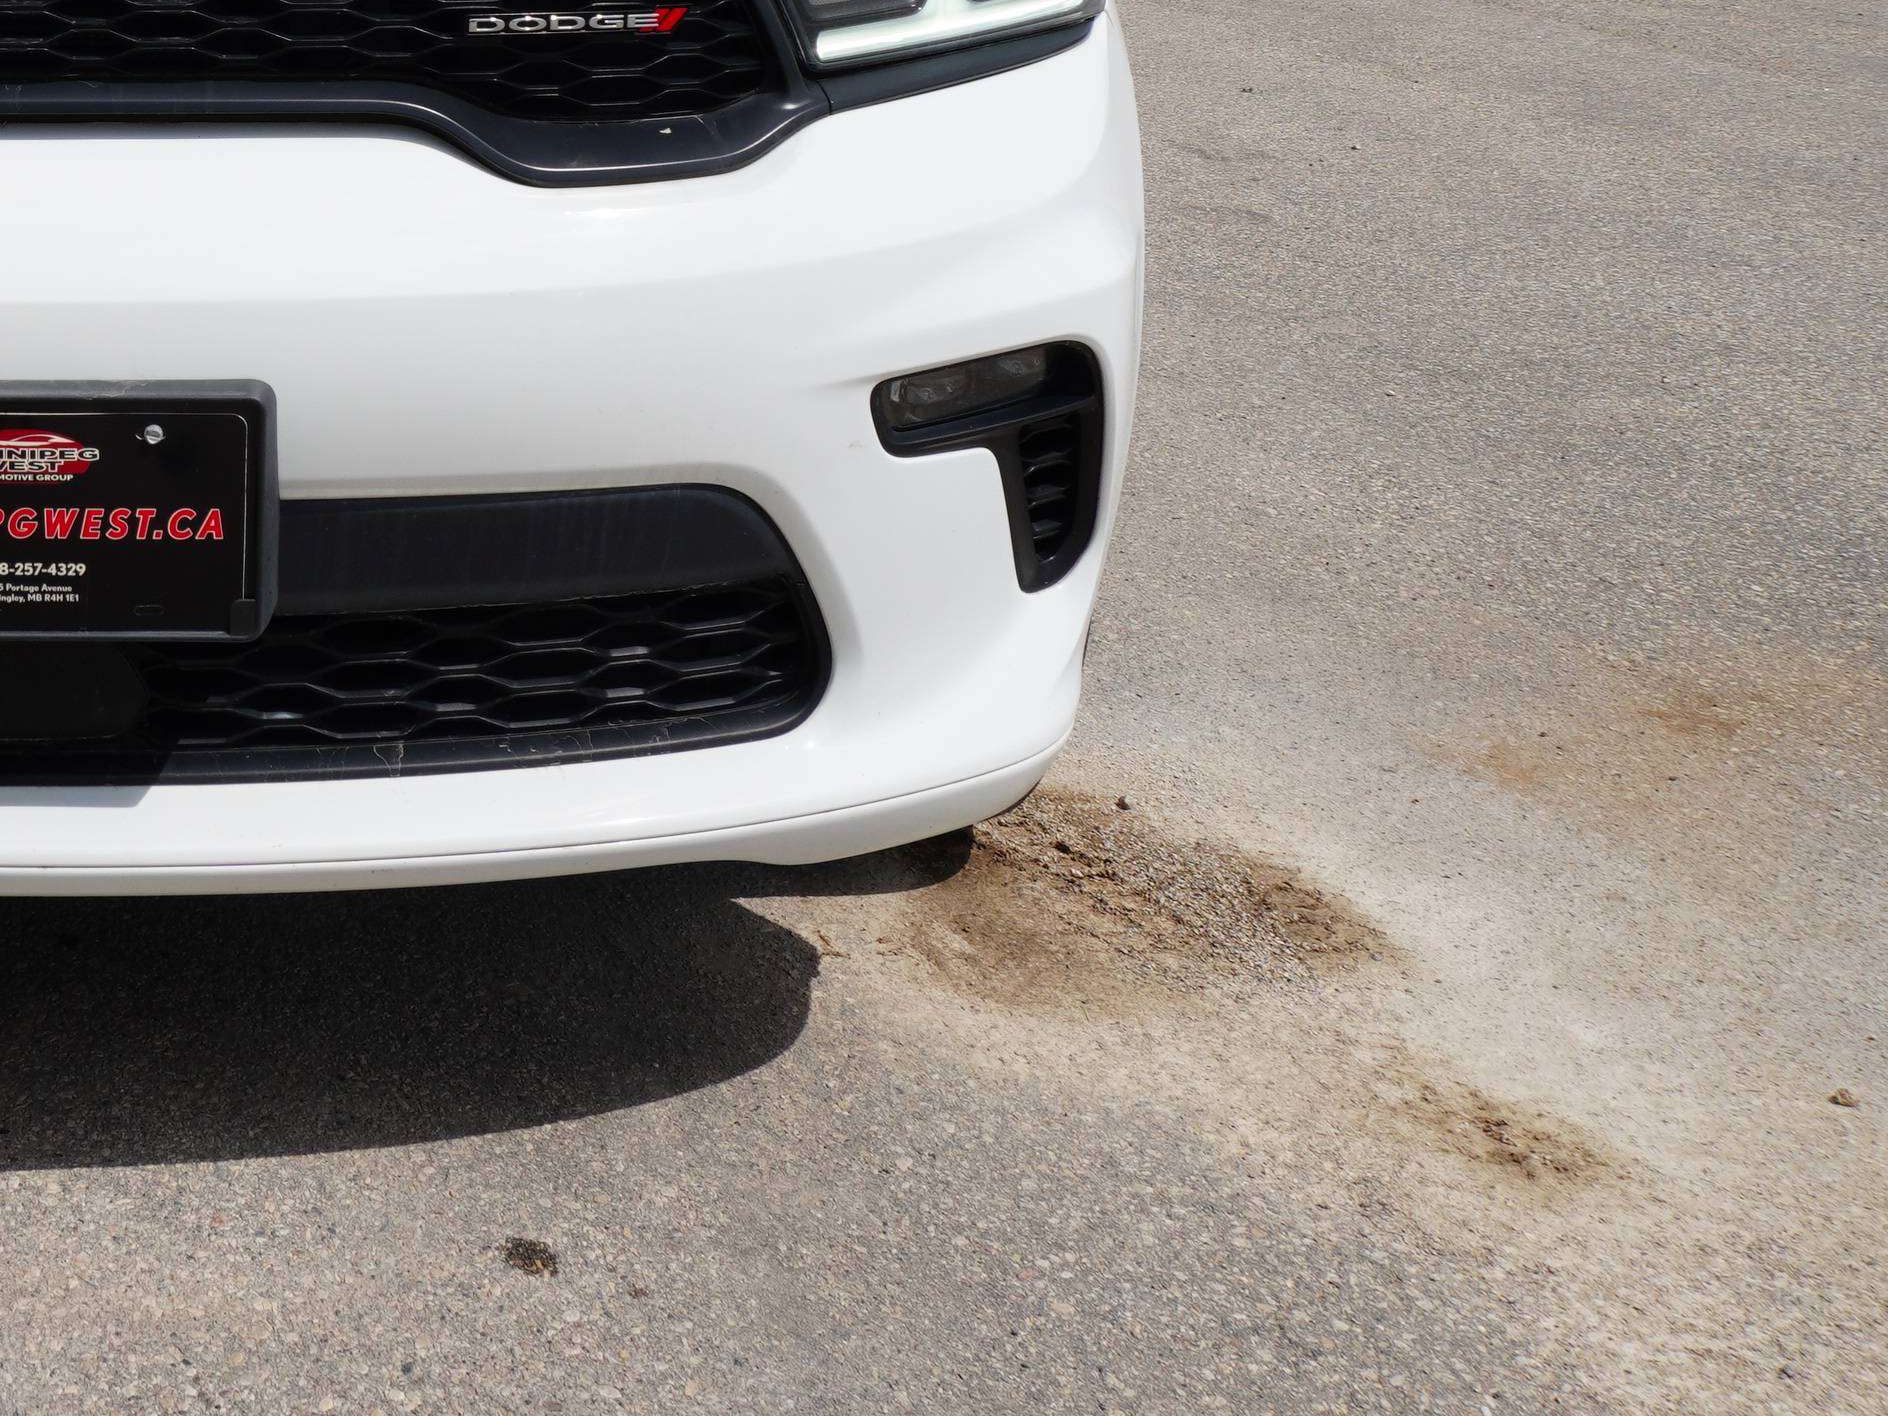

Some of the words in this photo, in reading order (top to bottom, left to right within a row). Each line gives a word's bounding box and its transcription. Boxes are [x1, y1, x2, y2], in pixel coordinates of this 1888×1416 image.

[468, 12, 660, 33] DODGE
[5, 583, 40, 593] Portage
[41, 584, 73, 592] Avenue
[27, 594, 42, 602] MB
[44, 594, 63, 602] R4H
[65, 594, 79, 602] 1E1
